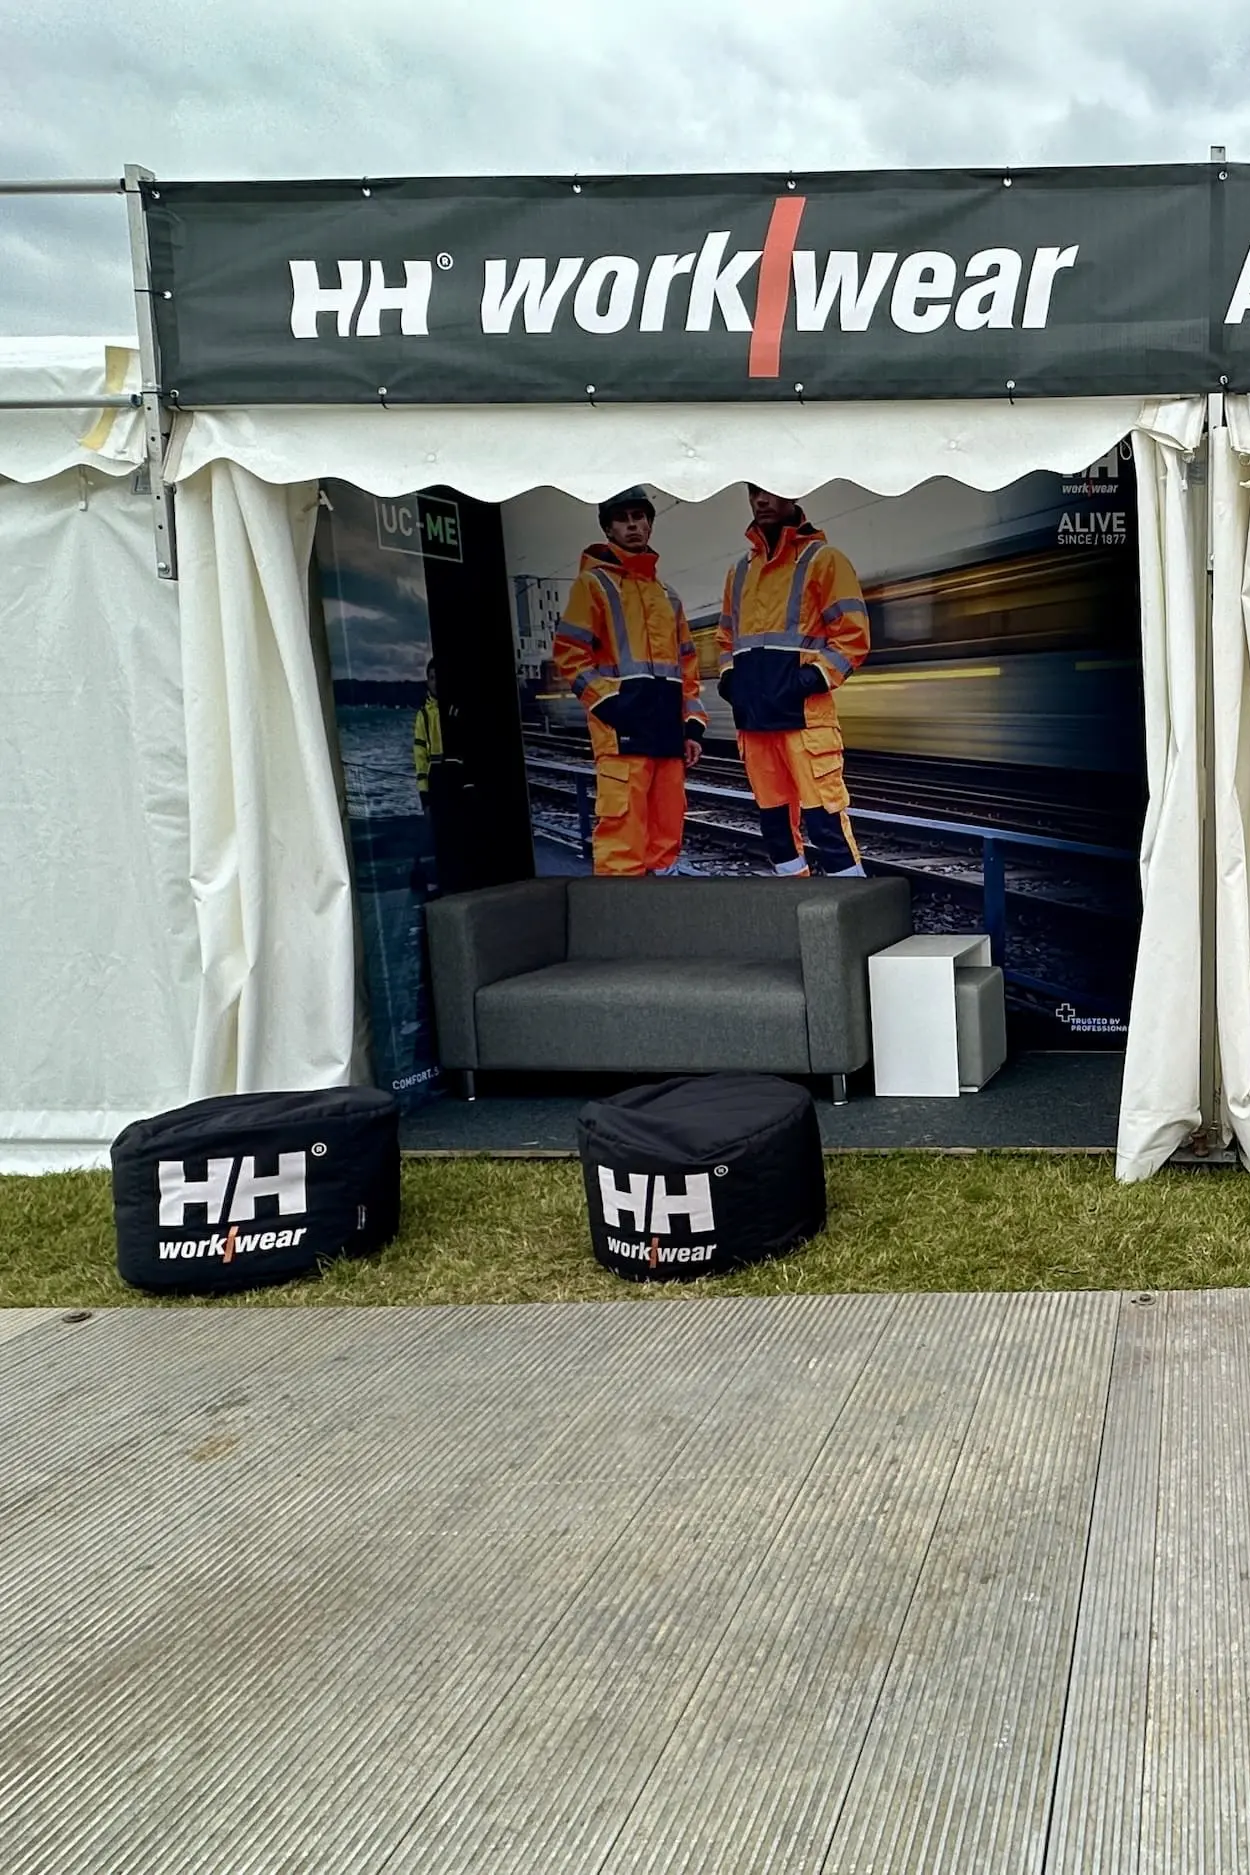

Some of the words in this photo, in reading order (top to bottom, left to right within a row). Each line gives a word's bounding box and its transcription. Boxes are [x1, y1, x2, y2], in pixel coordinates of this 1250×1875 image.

[382, 503, 458, 546] UC-ME
[1057, 512, 1126, 533] ALIVE
[1057, 533, 1092, 545] SINCE
[1101, 533, 1127, 545] 1877
[1071, 1017, 1108, 1025] TRUSTED
[1109, 1017, 1121, 1025] BY
